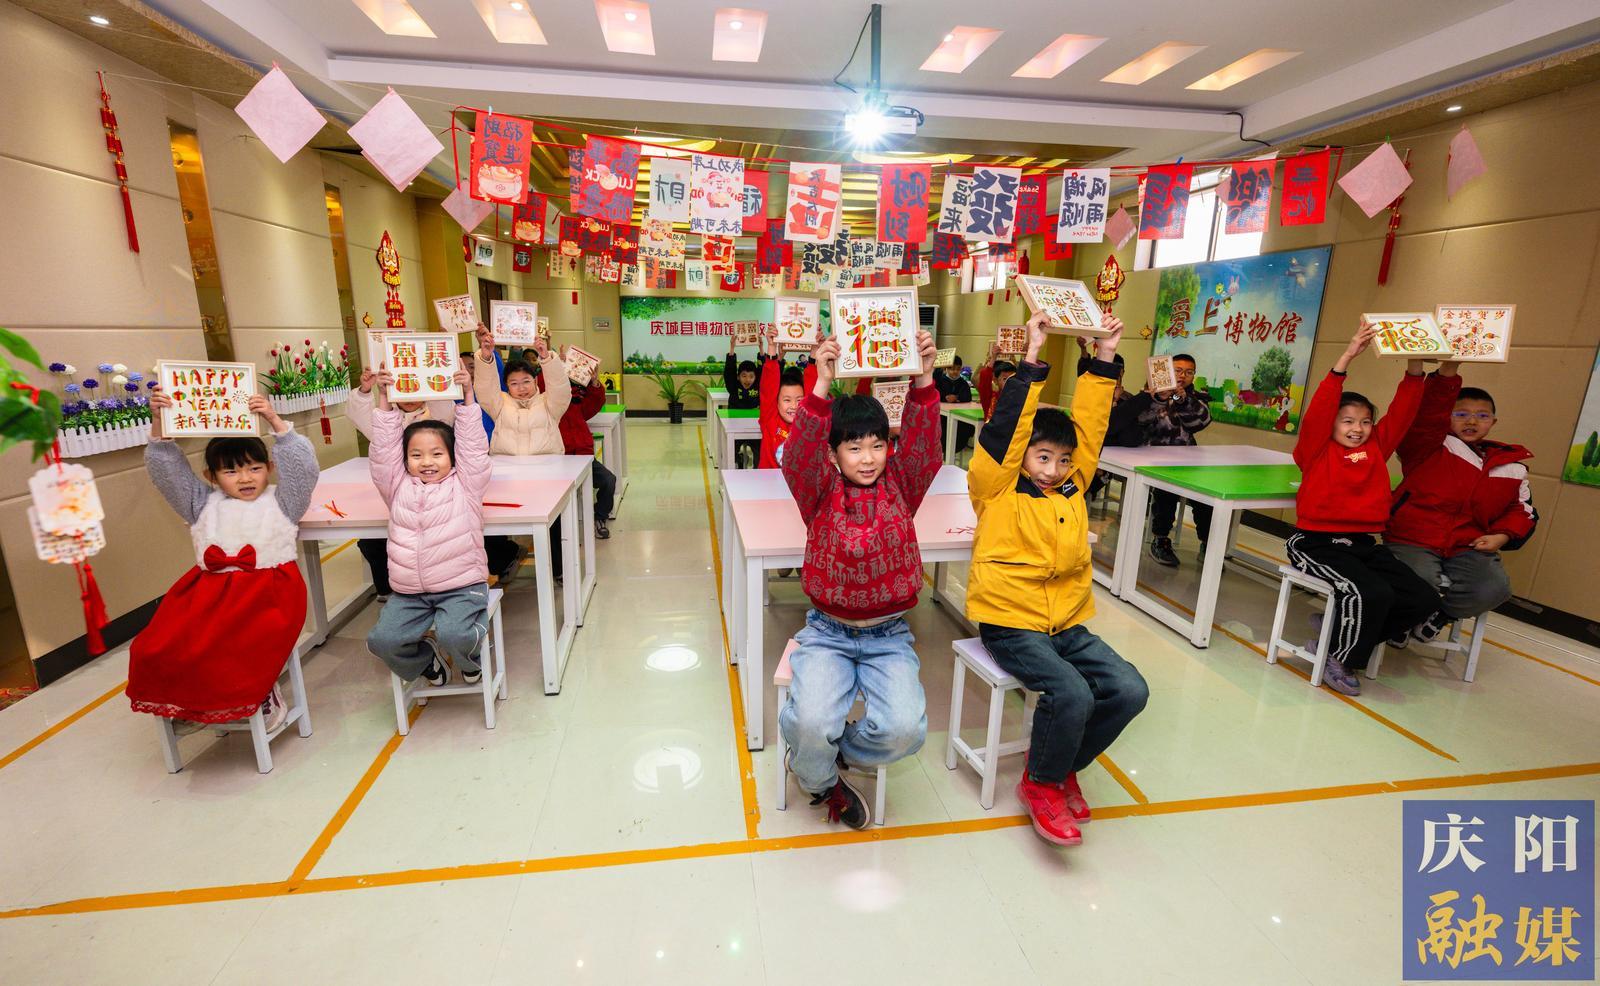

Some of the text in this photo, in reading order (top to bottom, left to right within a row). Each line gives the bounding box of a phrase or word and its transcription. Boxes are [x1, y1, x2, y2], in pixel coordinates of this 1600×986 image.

[172, 368, 244, 388] HAPPY
[191, 386, 227, 397] NEW
[188, 399, 231, 411] YEAR
[174, 412, 252, 430] 新年快乐
